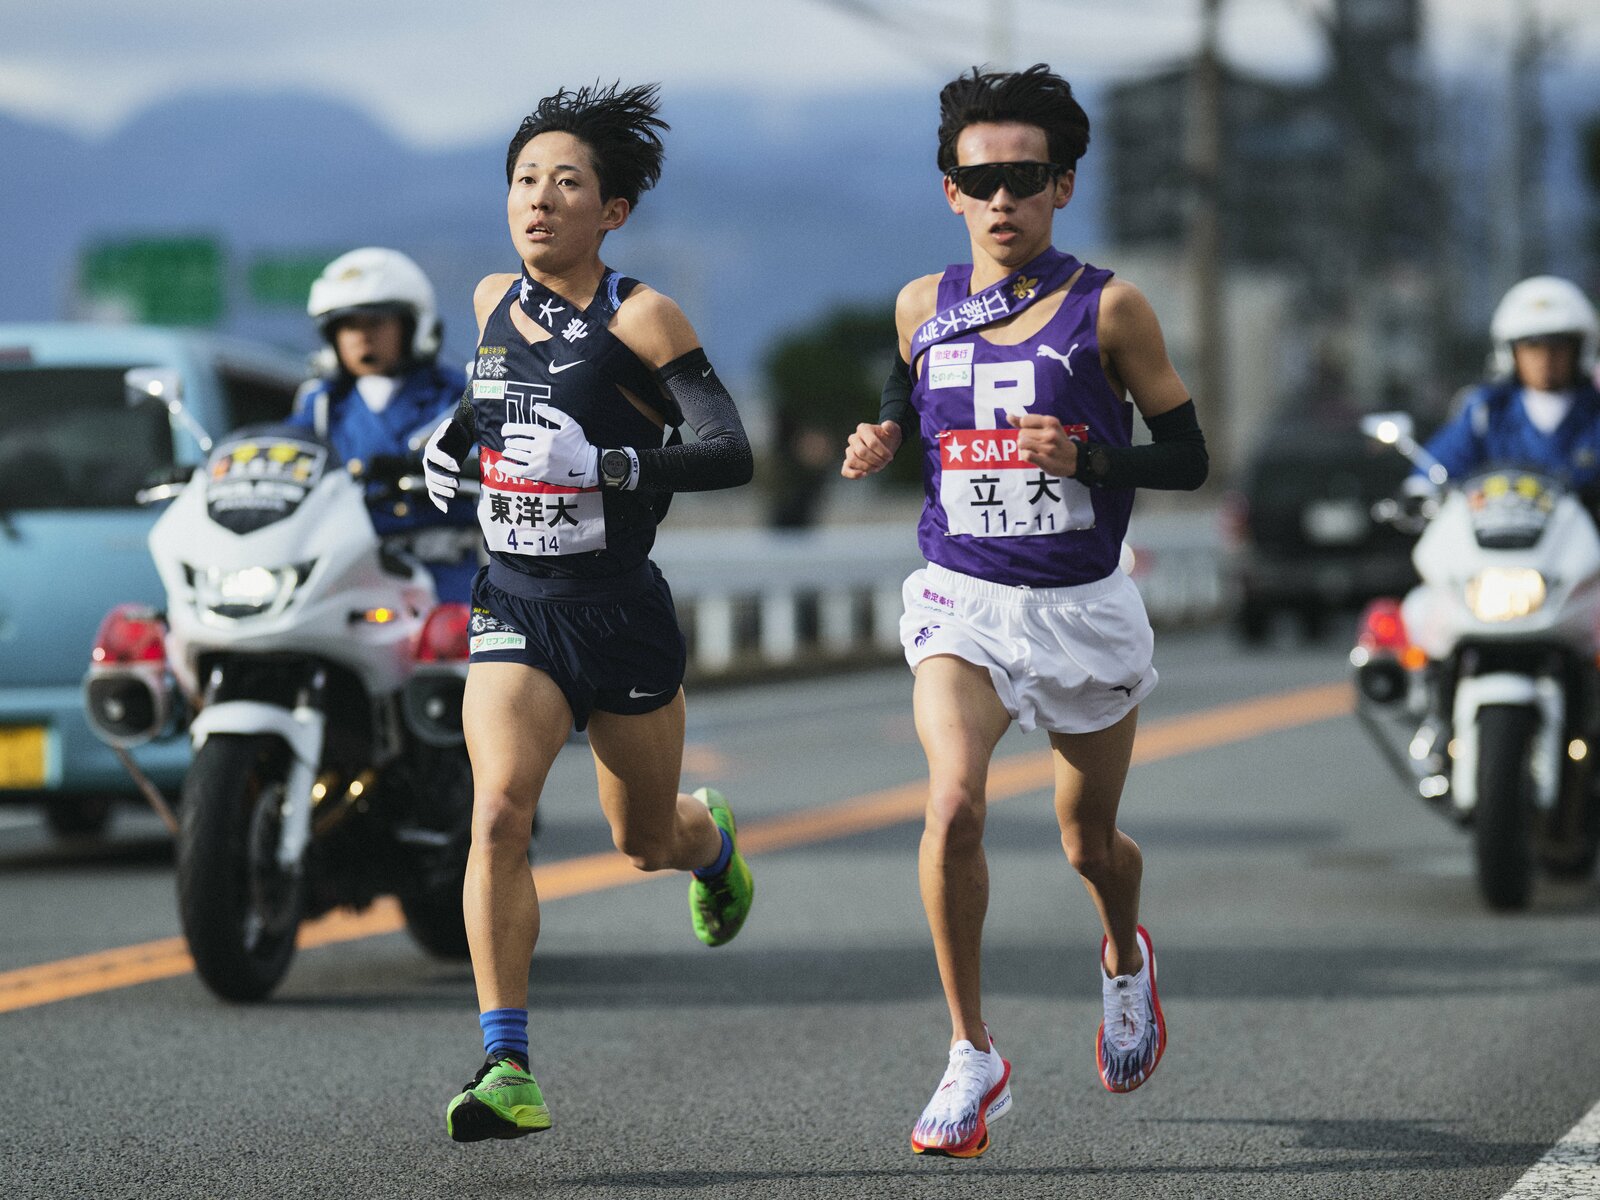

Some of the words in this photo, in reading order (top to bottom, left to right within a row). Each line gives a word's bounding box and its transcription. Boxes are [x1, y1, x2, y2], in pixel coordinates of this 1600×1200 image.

[919, 290, 1009, 343] 立教大学
[477, 356, 508, 378] むぎ茶
[974, 360, 1036, 430] R
[489, 493, 580, 528] 東洋大
